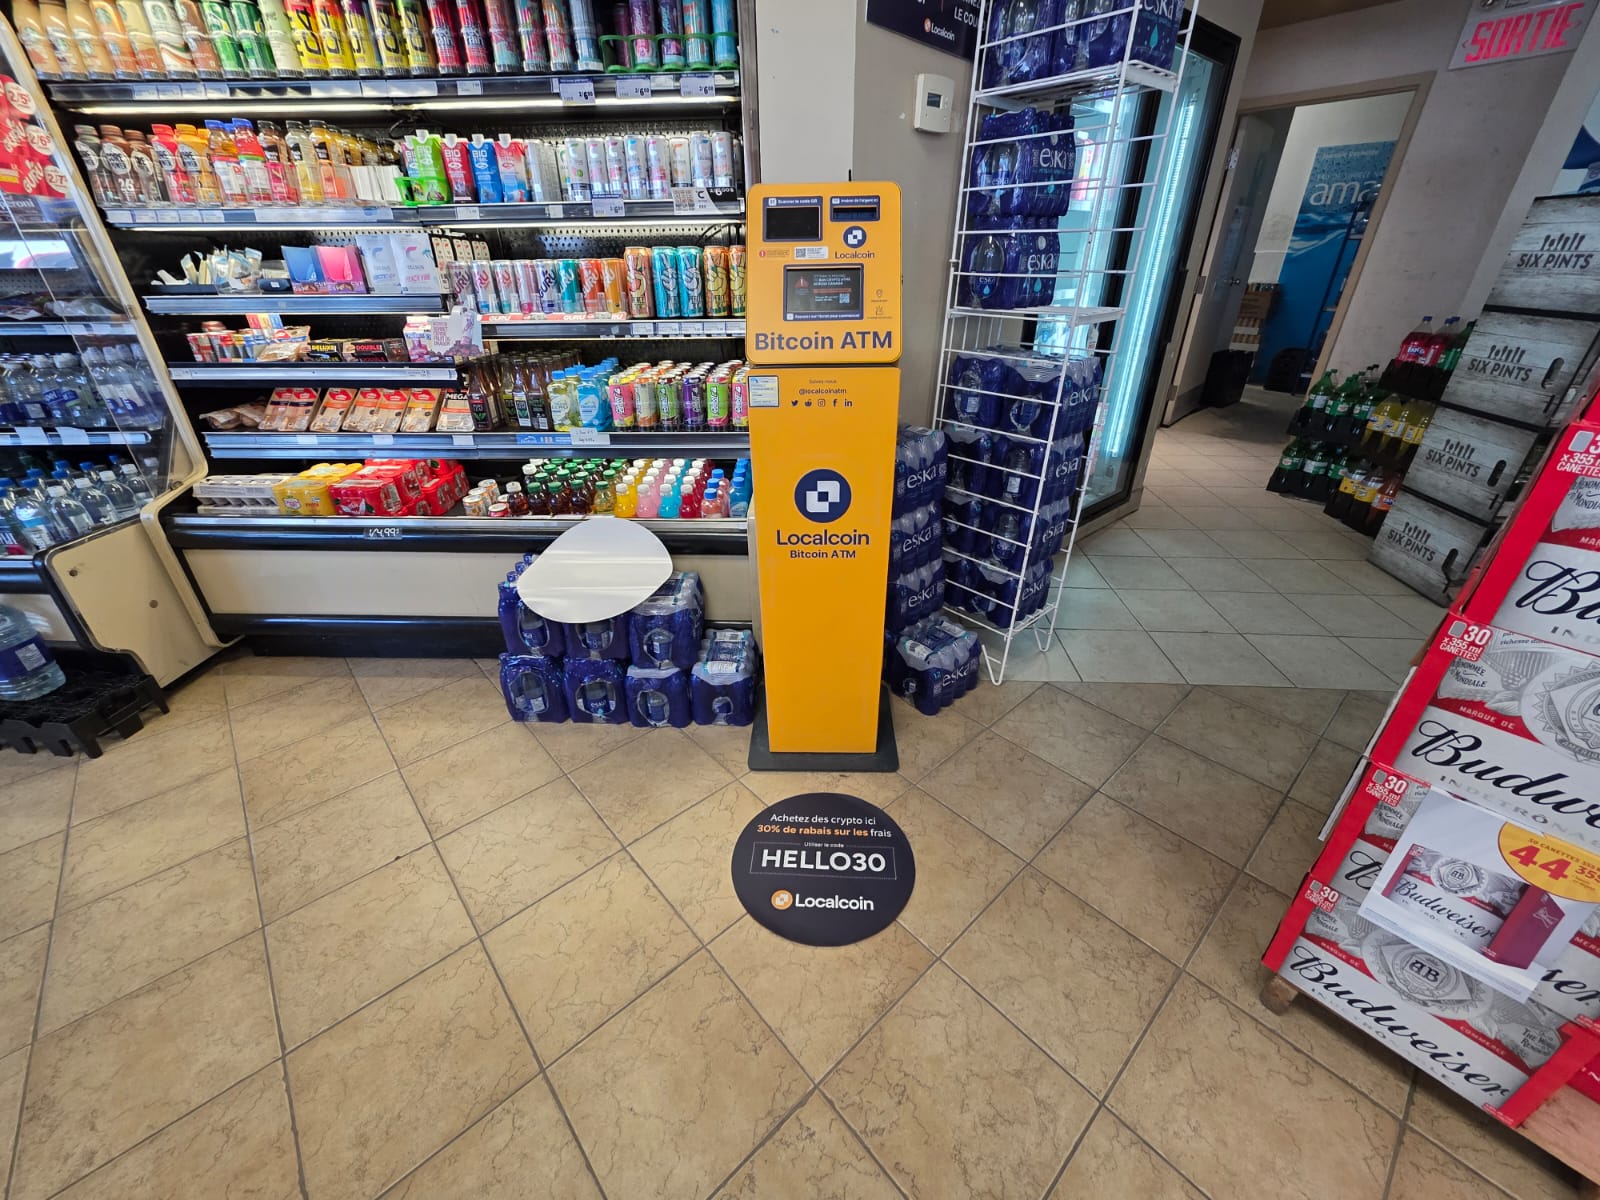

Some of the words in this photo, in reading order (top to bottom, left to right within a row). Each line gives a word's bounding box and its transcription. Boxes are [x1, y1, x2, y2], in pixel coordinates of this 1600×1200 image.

[954, 7, 964, 21] LE
[931, 23, 955, 41] Localcoin
[1464, 2, 1585, 62] SORTIE
[1039, 148, 1067, 170] eska
[835, 251, 875, 259] Localcoin
[1028, 253, 1055, 271] eska
[1516, 253, 1544, 268] SIX
[1542, 253, 1595, 269] PINTS
[755, 332, 833, 350] Bitcoin
[840, 331, 892, 349] ATM
[1467, 358, 1491, 374] SIX
[1490, 362, 1533, 382] PINTS
[445, 392, 468, 400] MEGA
[1426, 449, 1446, 465] SIX
[1445, 456, 1481, 478] PINTS
[1570, 452, 1596, 465] 355
[906, 466, 936, 489] eska
[1556, 461, 1600, 477] CANETTE
[776, 529, 870, 546] Localcoin
[902, 527, 932, 553] eska
[1387, 529, 1405, 546] SIX
[1404, 538, 1436, 562] PINTS
[790, 549, 828, 559] Bitcoin
[831, 549, 856, 559] ATM
[908, 584, 935, 608] eska
[1463, 625, 1491, 646] 30
[1439, 643, 1479, 662] CANETTES
[1449, 637, 1470, 650] 355
[1468, 645, 1482, 654] ml
[942, 663, 970, 687] eska
[1459, 705, 1497, 723] MARQUE
[1501, 720, 1516, 730] DE
[1384, 775, 1407, 794] 30
[770, 813, 809, 823] Achetez
[811, 815, 829, 824] des
[831, 816, 863, 826] crypto
[864, 816, 876, 825] ici
[757, 824, 781, 833] 30%
[783, 825, 797, 834] de
[799, 826, 832, 836] rabais
[853, 828, 869, 837] les
[870, 828, 892, 838] frais
[761, 849, 886, 872] HELLO30
[1509, 845, 1572, 880] 44
[795, 893, 875, 911] Localcoin
[1320, 886, 1339, 903] 30
[1394, 878, 1496, 940] Budweiser
[1320, 942, 1347, 960] MARQUE
[1290, 945, 1510, 1097] Budweiser
